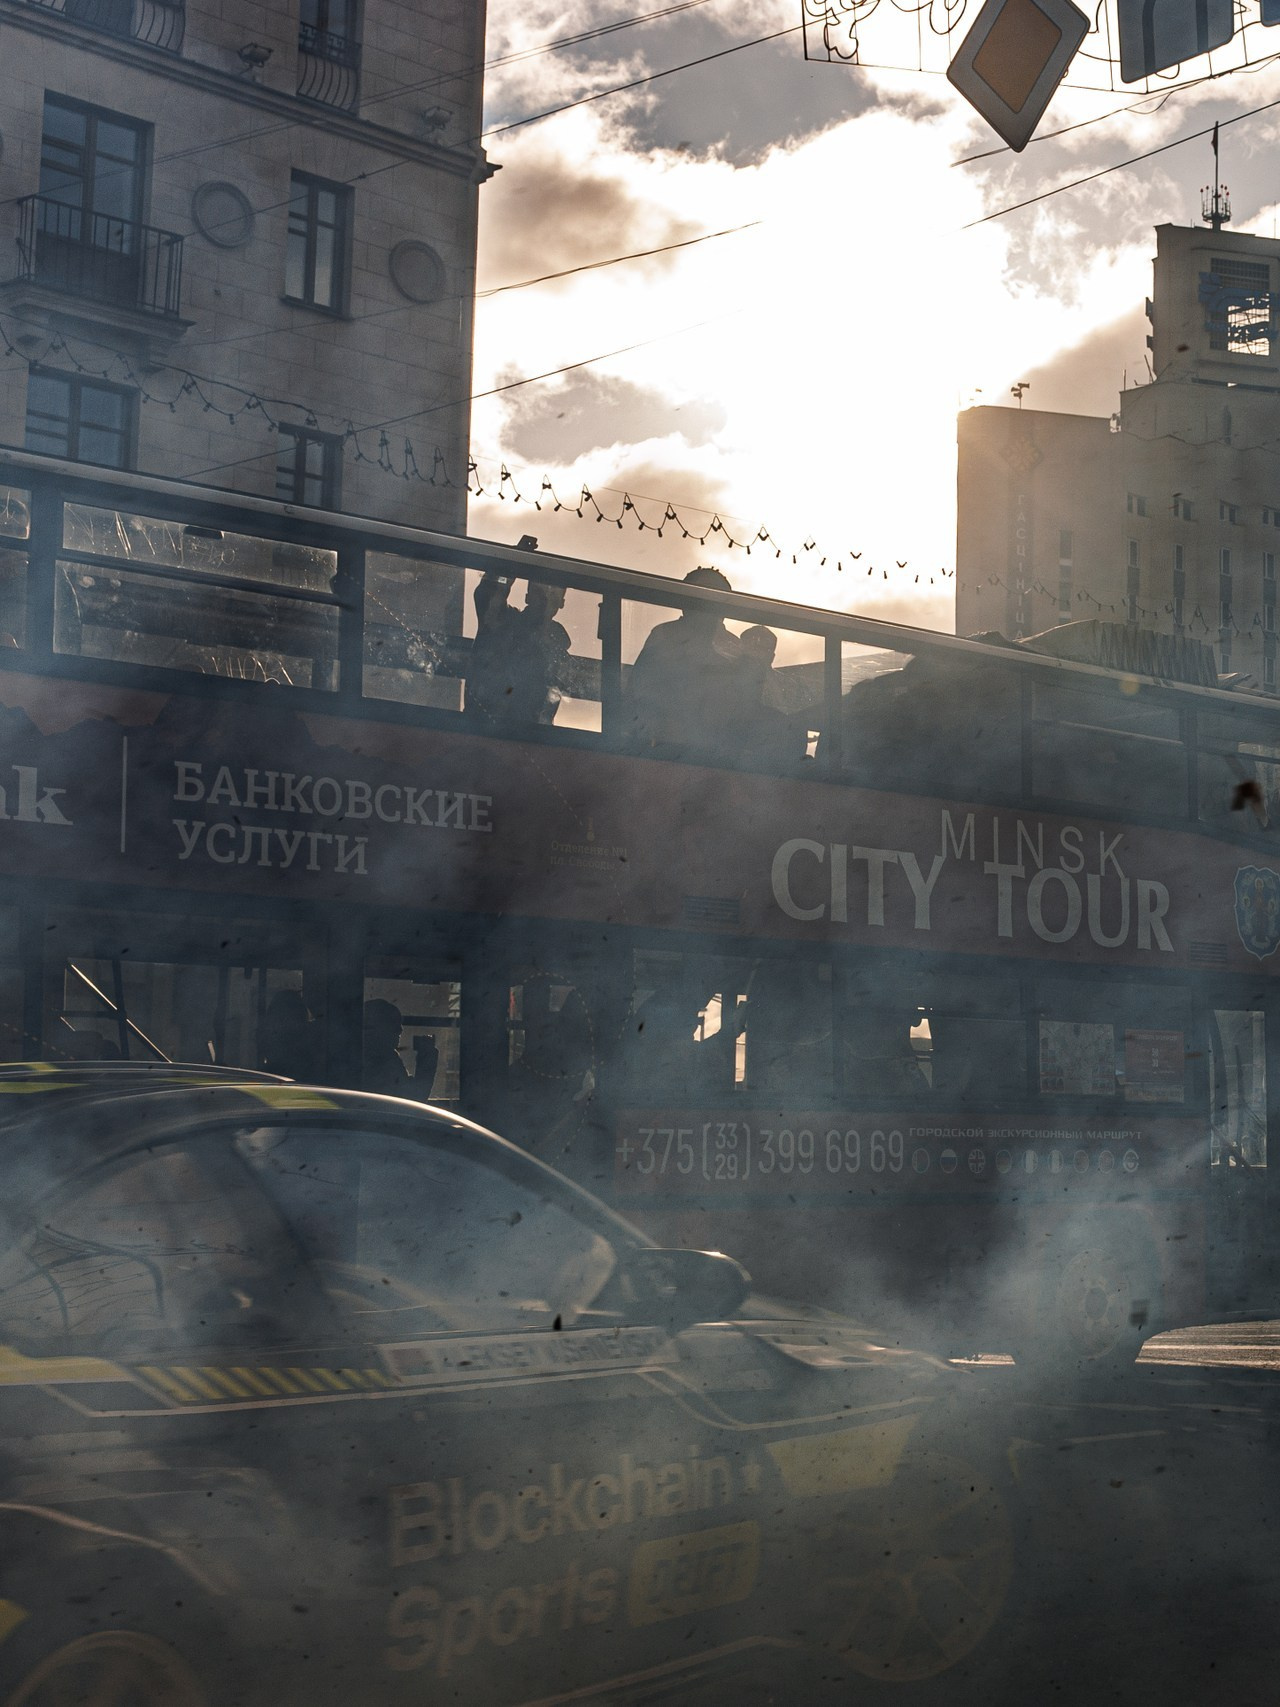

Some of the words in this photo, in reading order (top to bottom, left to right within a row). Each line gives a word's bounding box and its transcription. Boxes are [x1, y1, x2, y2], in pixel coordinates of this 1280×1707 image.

[173, 760, 493, 833] БАНКОВСКИЕ
[172, 819, 369, 876] УСЛУГИ
[941, 808, 1125, 878] MINSK
[771, 838, 947, 930] CITY
[984, 861, 1175, 952] TOUR
[615, 1128, 695, 1174] +375
[758, 1129, 815, 1174] 399
[825, 1129, 861, 1174] 69
[870, 1129, 904, 1174] 69
[909, 1126, 984, 1138] ГОРОДСКОЙ
[987, 1128, 1083, 1139] ЭКСКУРСИОННЫЙ
[1086, 1130, 1142, 1141] МАРШРУТ
[389, 1444, 733, 1568] Blockchain
[384, 1556, 620, 1679] Sports
